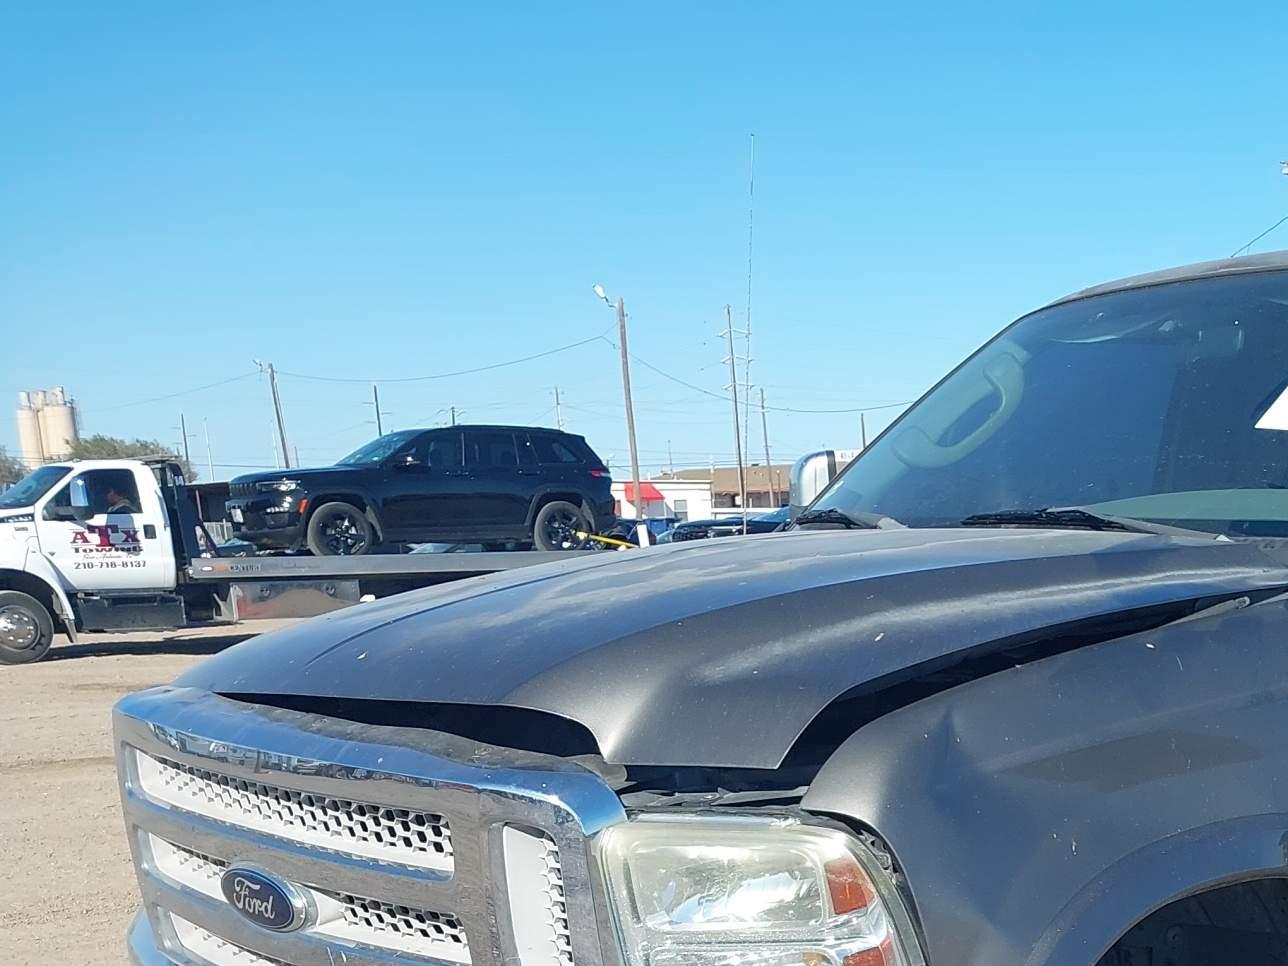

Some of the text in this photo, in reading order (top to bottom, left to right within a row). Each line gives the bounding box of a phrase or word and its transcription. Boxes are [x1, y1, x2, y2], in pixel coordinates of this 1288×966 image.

[70, 524, 141, 547] ATX
[73, 561, 146, 569] 210-718-8137
[233, 877, 276, 919] Ford
